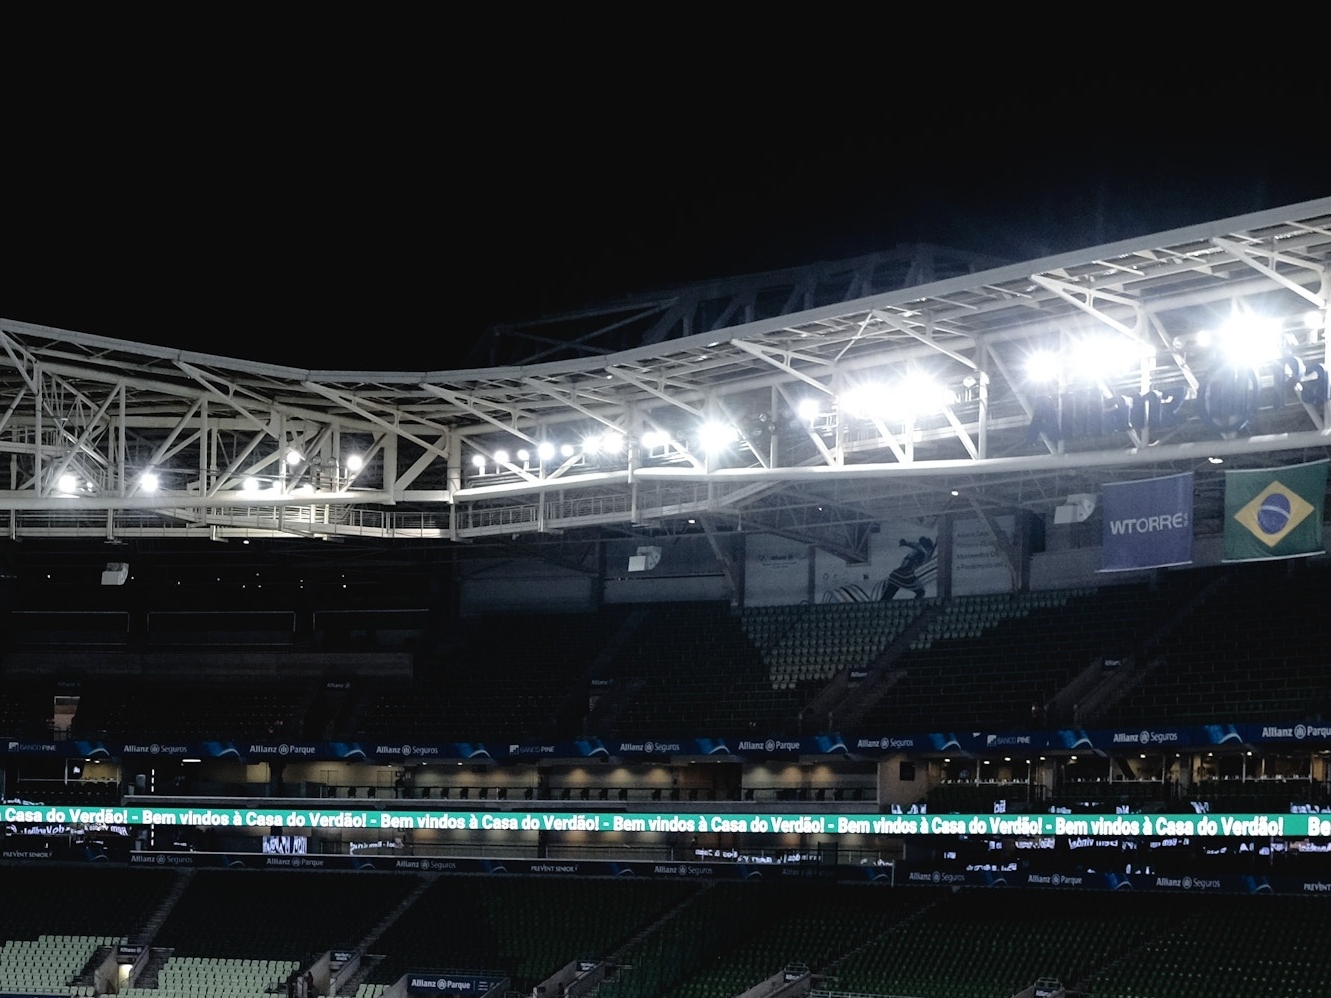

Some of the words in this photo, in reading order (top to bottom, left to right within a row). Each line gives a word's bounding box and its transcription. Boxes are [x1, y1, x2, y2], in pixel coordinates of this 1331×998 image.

[1262, 727, 1293, 737] Allianz
[1113, 733, 1140, 743] Allianz
[124, 745, 151, 753] Allianz
[620, 744, 644, 752] Allianz
[738, 742, 764, 750] Allianz
[776, 741, 800, 751] Parque
[857, 740, 880, 748] Allianz
[249, 745, 277, 753] Allianz
[289, 746, 315, 755] Parque
[376, 746, 402, 754] Allianz
[4, 808, 43, 822] Casa
[45, 808, 66, 823] do
[68, 809, 128, 823] Verdão!
[142, 810, 176, 825] Bem
[179, 810, 230, 826] vindos
[232, 811, 243, 826] à
[245, 812, 284, 826] Casa
[286, 812, 306, 827] do
[308, 812, 367, 827] Verdão!
[380, 813, 414, 828] Bem
[416, 814, 466, 828] vindos
[469, 814, 479, 829] à
[481, 815, 518, 830] Casa
[521, 815, 540, 830] do
[542, 815, 600, 830] Verdão!
[613, 816, 647, 831] Bem
[648, 816, 696, 832] vindos
[698, 816, 708, 832] à
[710, 817, 747, 832] Casa
[750, 816, 768, 833] do
[770, 816, 825, 833] Verdão!
[837, 817, 871, 834] Bem
[872, 817, 918, 834] vindos
[920, 817, 929, 834] à
[931, 817, 966, 834] Casa
[968, 816, 987, 834] do
[989, 816, 1043, 834] Verdão!
[1055, 817, 1088, 835] Bem
[1090, 816, 1140, 835] vindos
[1142, 816, 1153, 835] à
[1155, 817, 1194, 835] Casa
[1197, 816, 1218, 836] do
[1220, 816, 1284, 836] Verdão!
[411, 978, 436, 988] Allianz
[447, 979, 471, 991] Parque
